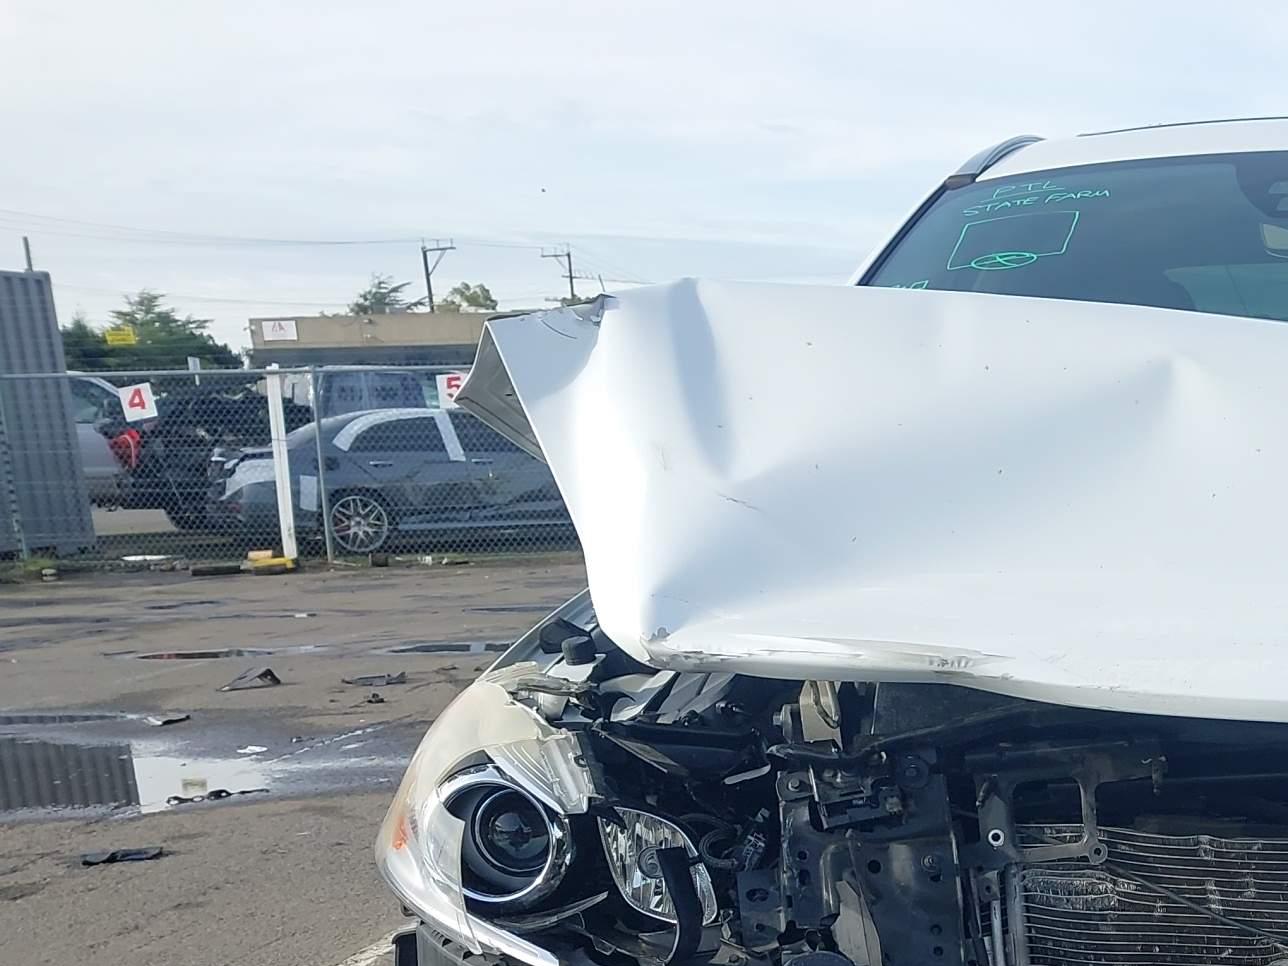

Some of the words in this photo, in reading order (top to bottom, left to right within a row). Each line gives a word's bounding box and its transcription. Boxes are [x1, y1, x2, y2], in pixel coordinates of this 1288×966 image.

[962, 198, 1036, 217] STATE
[1045, 190, 1110, 203] FARM
[128, 388, 146, 410] 4
[447, 376, 462, 399] 5
